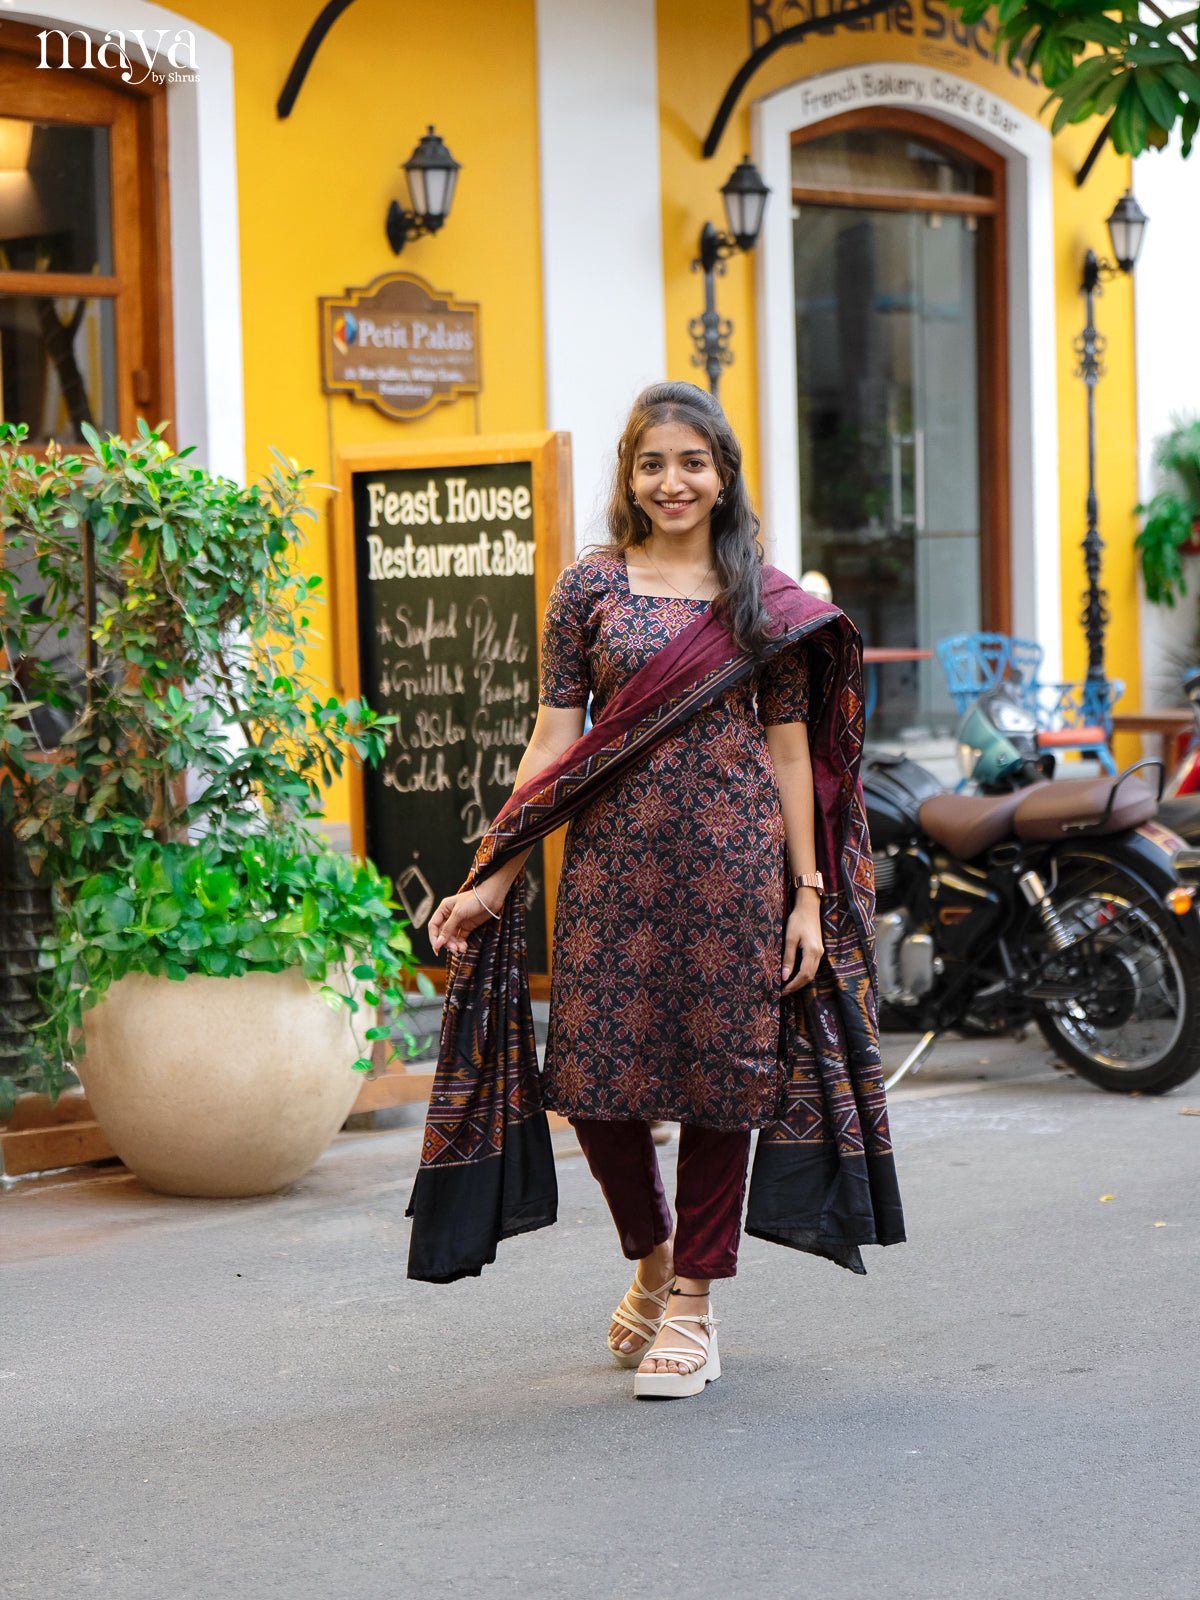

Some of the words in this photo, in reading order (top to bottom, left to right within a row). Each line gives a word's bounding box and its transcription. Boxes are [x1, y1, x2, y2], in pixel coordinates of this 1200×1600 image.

[358, 319, 408, 348] Petit
[411, 321, 474, 350] Palais
[367, 479, 443, 527] Feast
[445, 478, 532, 523] House
[457, 750, 482, 804] of
